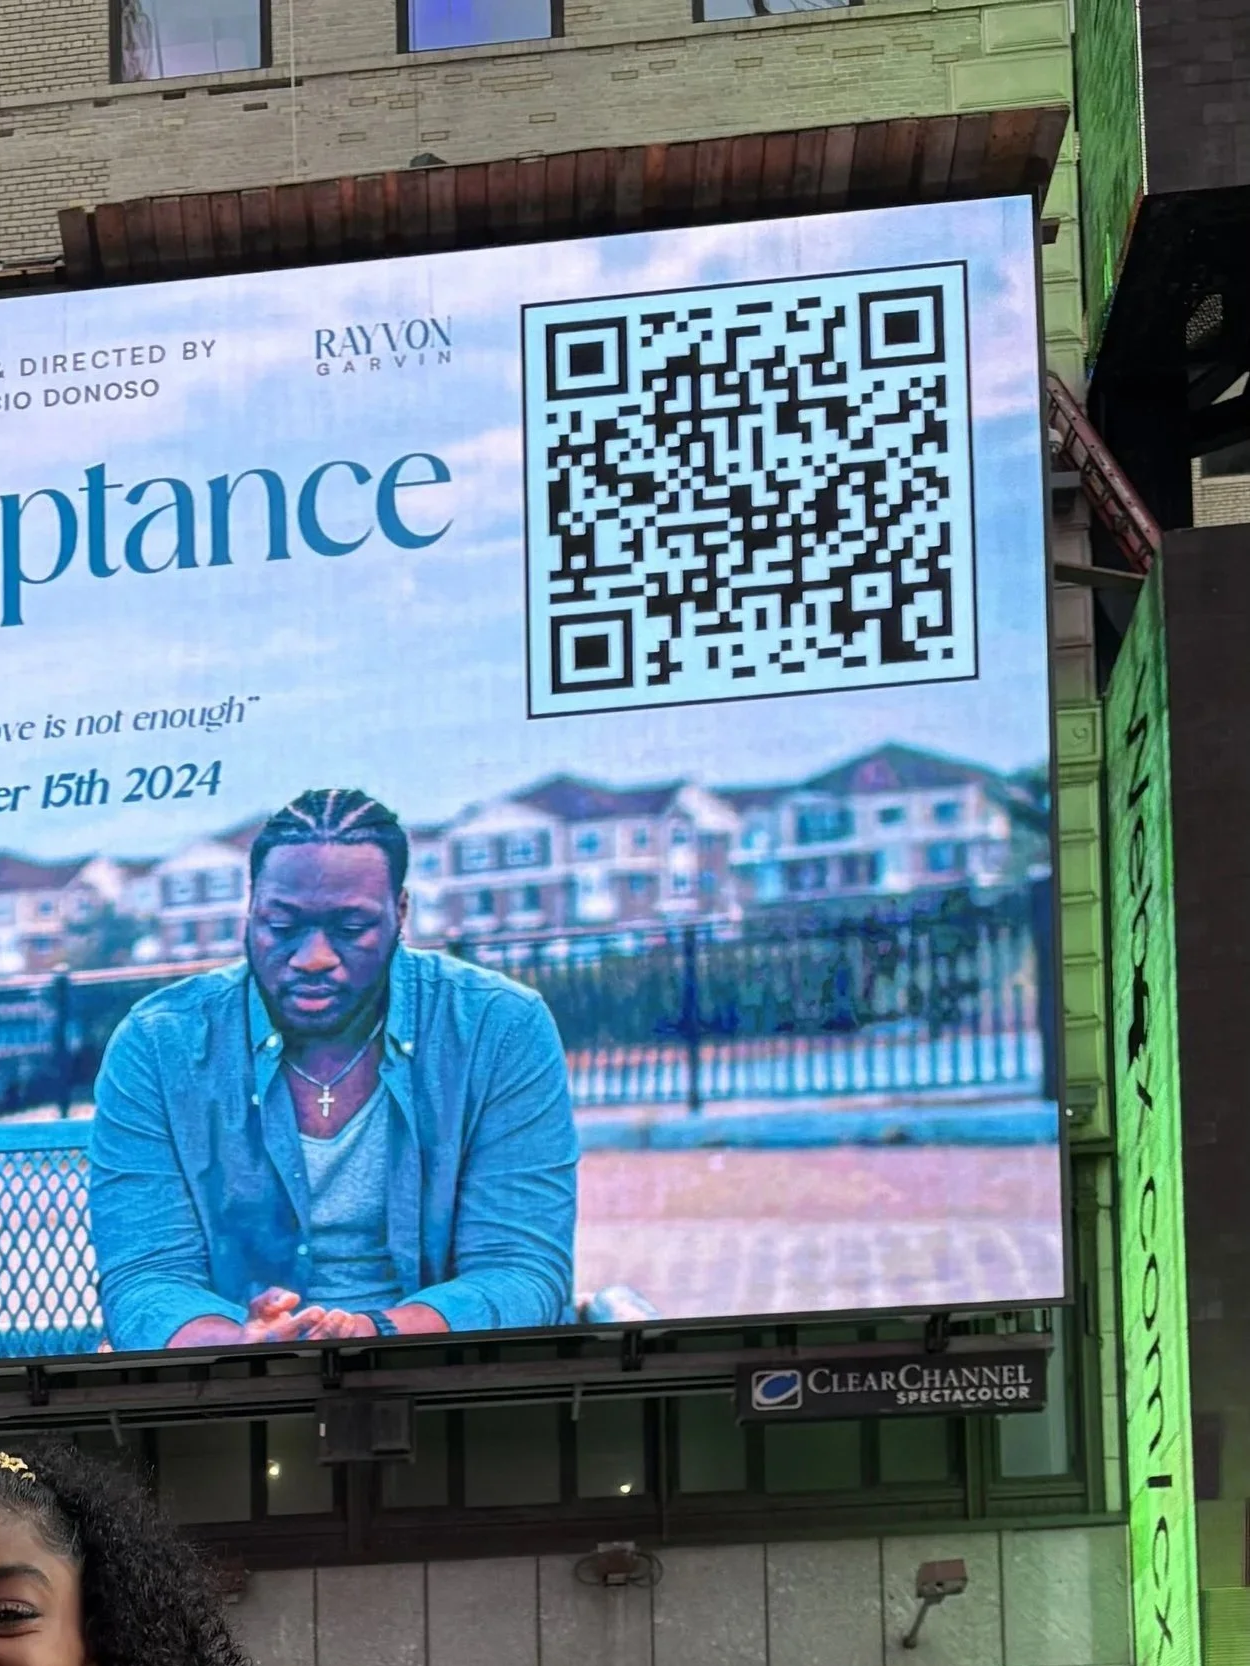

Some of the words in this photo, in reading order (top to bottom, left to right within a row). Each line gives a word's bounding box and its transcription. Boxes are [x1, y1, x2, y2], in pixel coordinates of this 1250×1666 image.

[315, 316, 452, 360] RAYVON
[20, 344, 166, 377] DIRECTED
[182, 339, 217, 361] BY
[316, 351, 452, 376] GARVIN
[44, 378, 161, 408] DONOSO
[43, 713, 66, 739] is
[75, 709, 124, 736] not
[41, 768, 111, 811] 15th
[122, 760, 224, 804] 2024
[896, 1386, 1031, 1406] SPECTACOLOR
